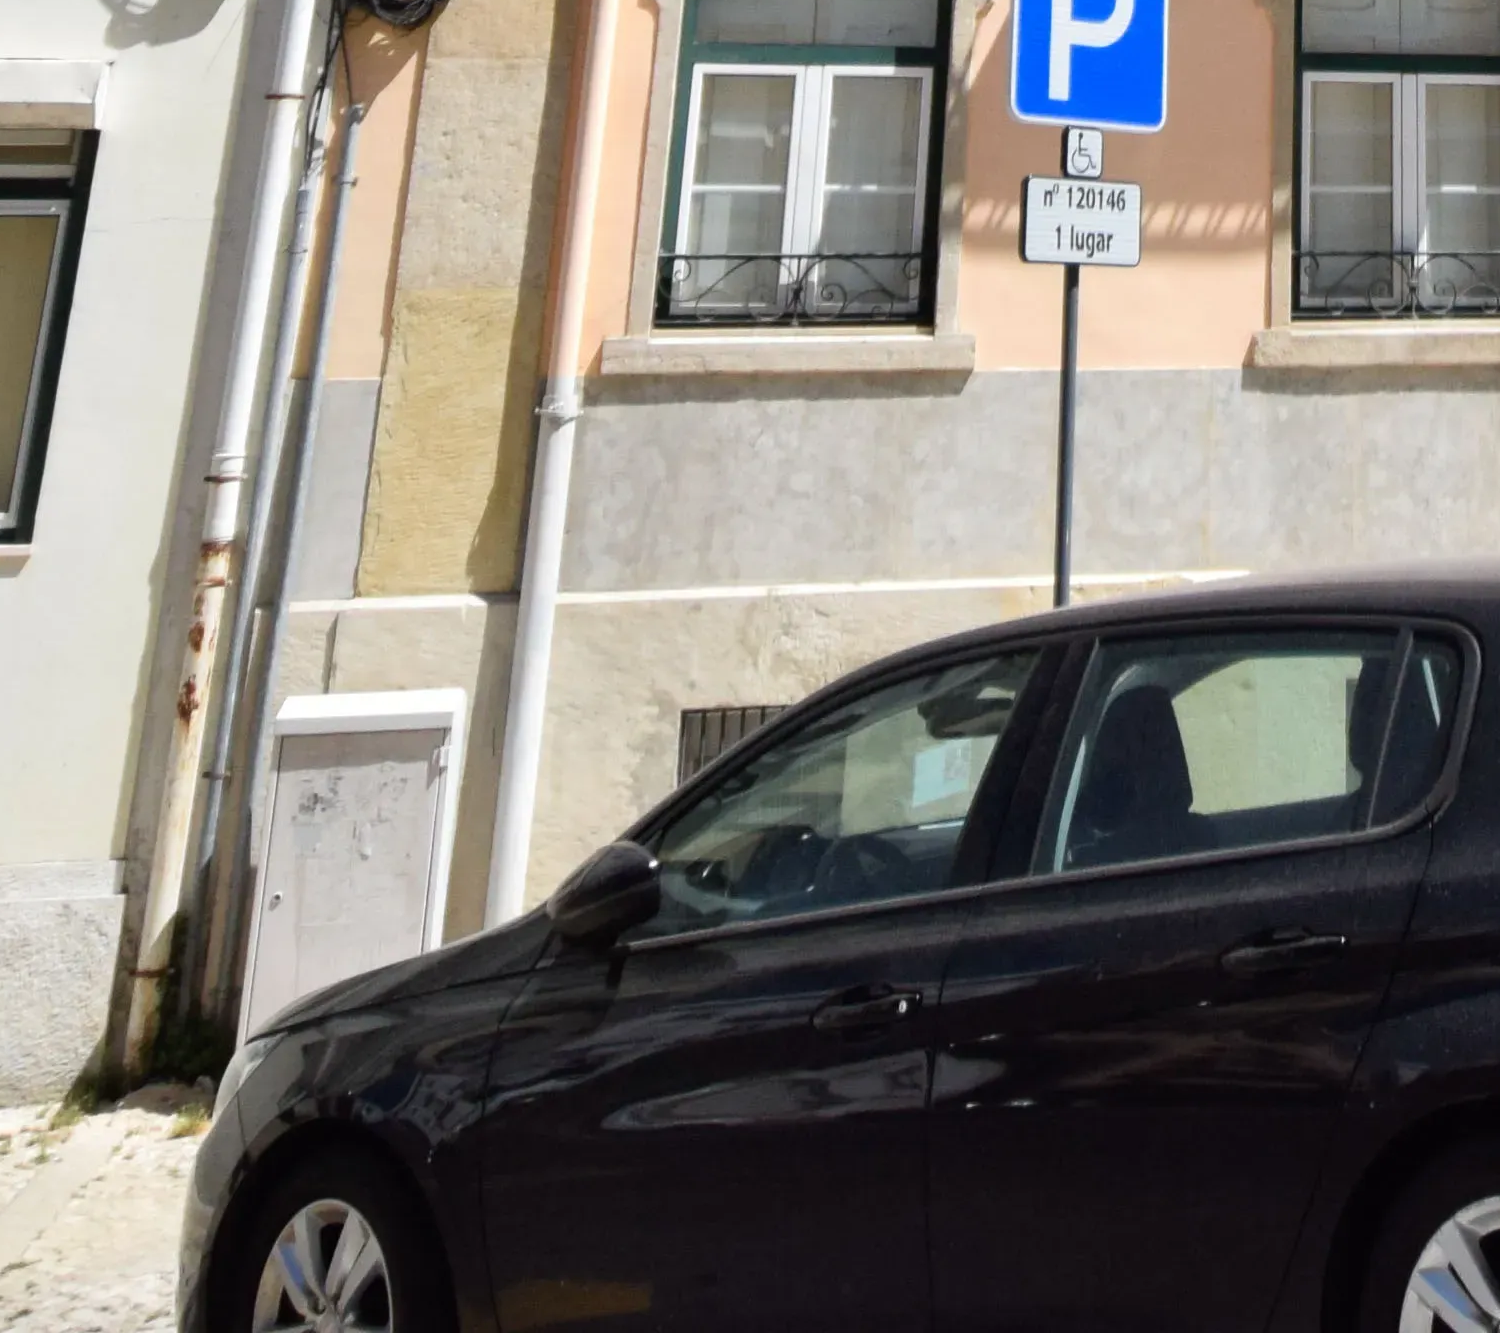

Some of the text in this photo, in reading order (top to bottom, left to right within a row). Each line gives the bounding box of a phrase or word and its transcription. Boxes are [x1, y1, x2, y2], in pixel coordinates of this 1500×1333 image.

[1067, 185, 1127, 213] 120146
[1055, 224, 1114, 259] 1 lugar
